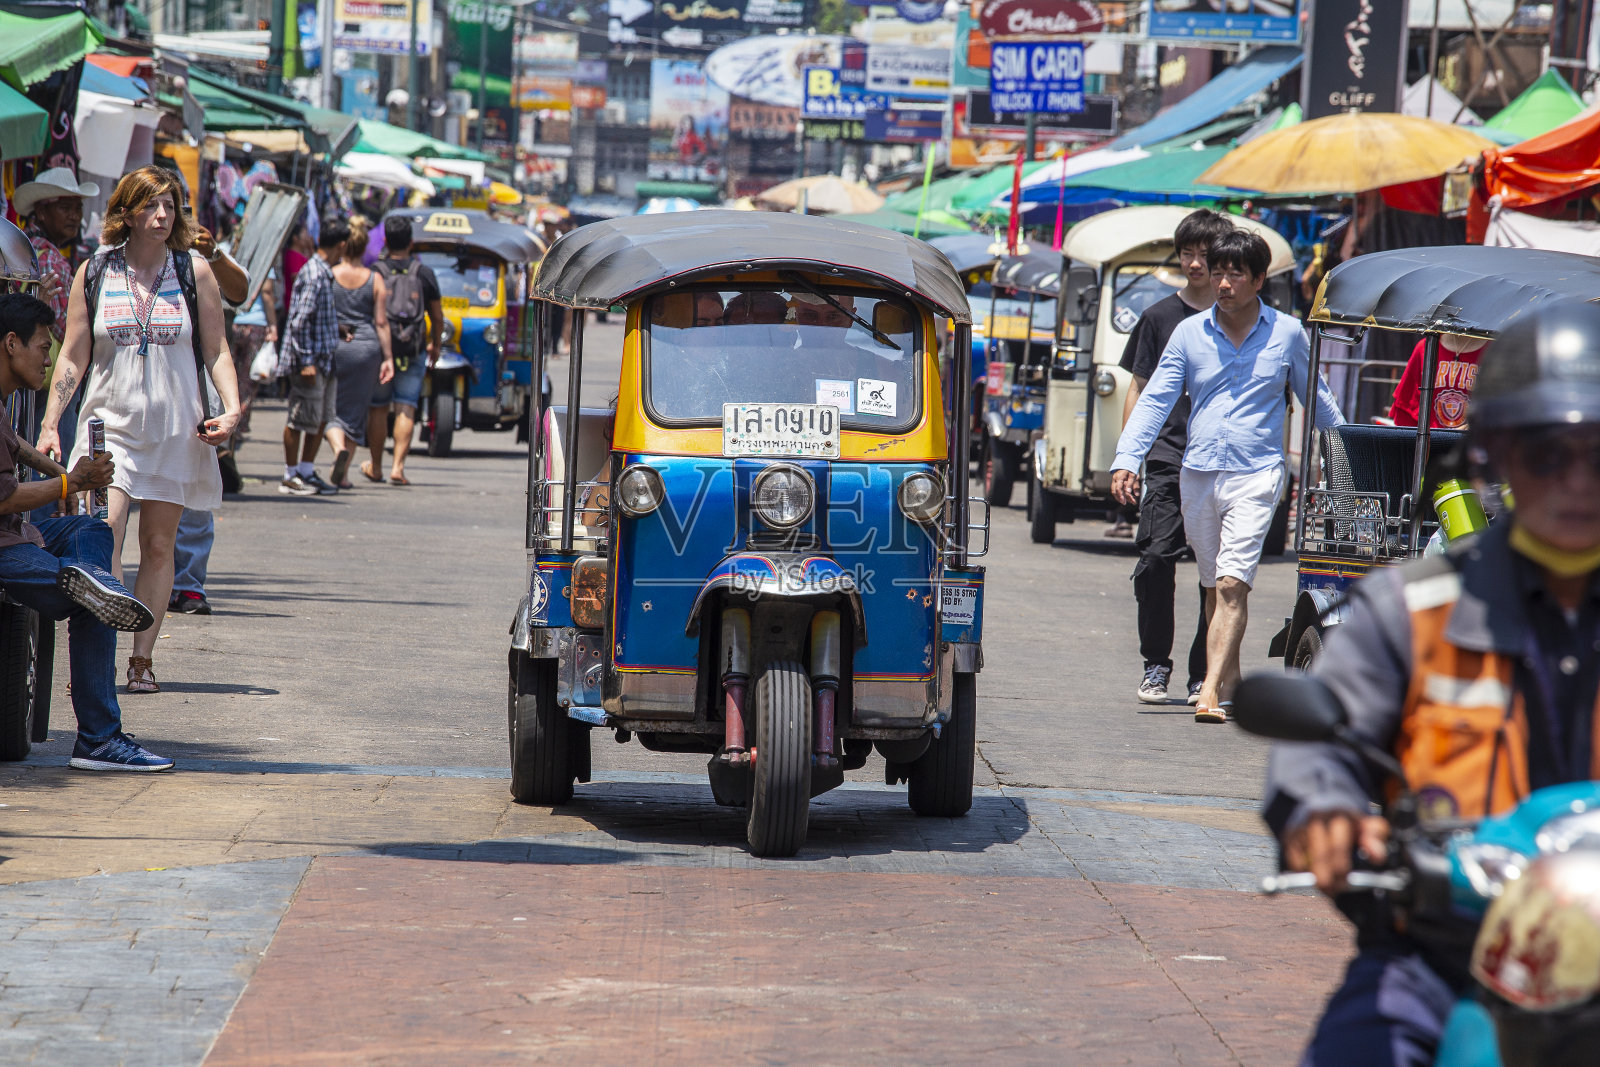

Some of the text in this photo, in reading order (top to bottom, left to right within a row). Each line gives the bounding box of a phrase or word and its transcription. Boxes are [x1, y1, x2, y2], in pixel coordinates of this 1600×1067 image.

[1008, 8, 1078, 33] Charlie
[992, 47, 1083, 80] SIM CARD
[992, 92, 1034, 111] UNLOCK
[1047, 92, 1082, 111] PHONE
[1329, 92, 1376, 106] CLIFF
[435, 216, 463, 228] TAXI
[1434, 360, 1479, 391] RVIS
[832, 390, 849, 398] 2561
[954, 588, 960, 597] IS
